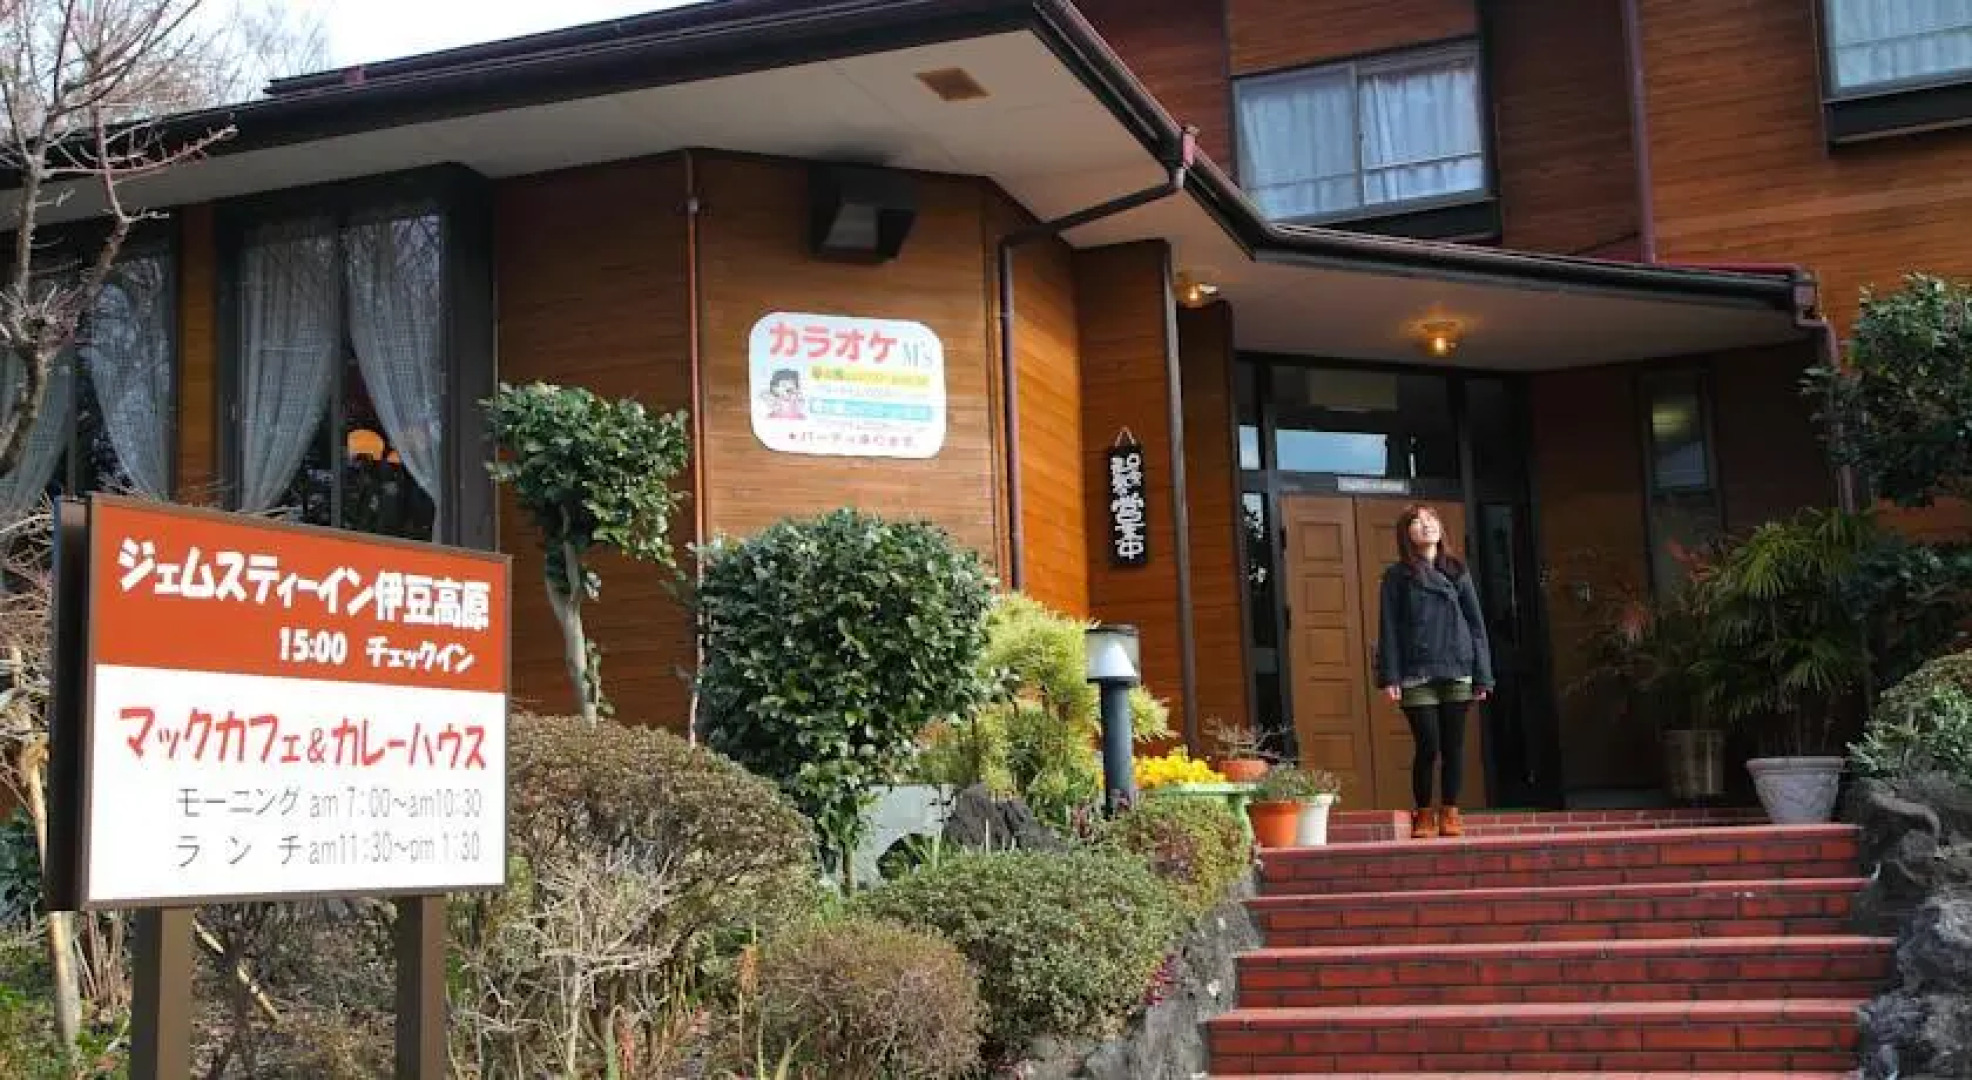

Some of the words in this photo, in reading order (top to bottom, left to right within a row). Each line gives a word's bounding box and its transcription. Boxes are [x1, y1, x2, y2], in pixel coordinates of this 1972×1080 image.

[769, 321, 897, 362] カラオケ
[117, 536, 491, 631] ジェムスティーイン伊豆高原
[279, 626, 348, 665] 15:00
[365, 635, 475, 674] チェックイン
[118, 706, 486, 770] マックカフェ&カレーハウス
[177, 786, 301, 817] モーニング
